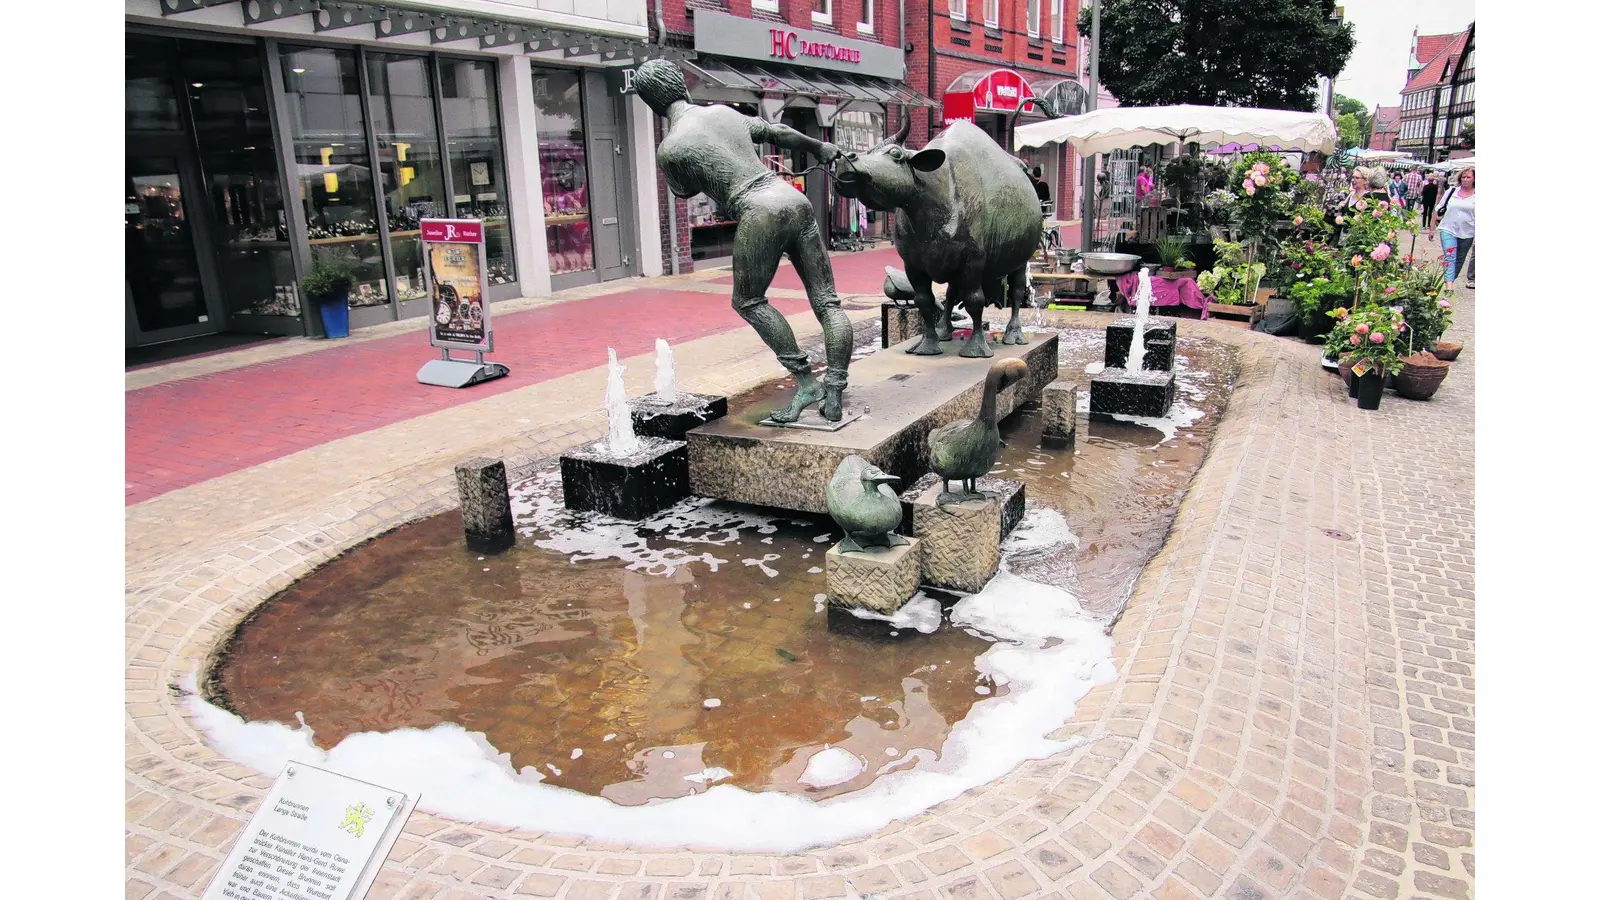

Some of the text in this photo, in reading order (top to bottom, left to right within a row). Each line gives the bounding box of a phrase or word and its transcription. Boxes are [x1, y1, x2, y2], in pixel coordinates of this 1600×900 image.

[769, 28, 861, 63] HC PARFÜMERIE
[996, 85, 1017, 97] Weltbild
[278, 797, 309, 812] Kuhbrunnen
[274, 805, 308, 821] Lange Straße
[248, 847, 258, 856] zur
[258, 829, 269, 838] Der
[270, 833, 301, 848] Kuhbrunnen
[320, 850, 332, 860] vom
[276, 865, 295, 877] Dieser
[298, 873, 321, 887] Brunnen
